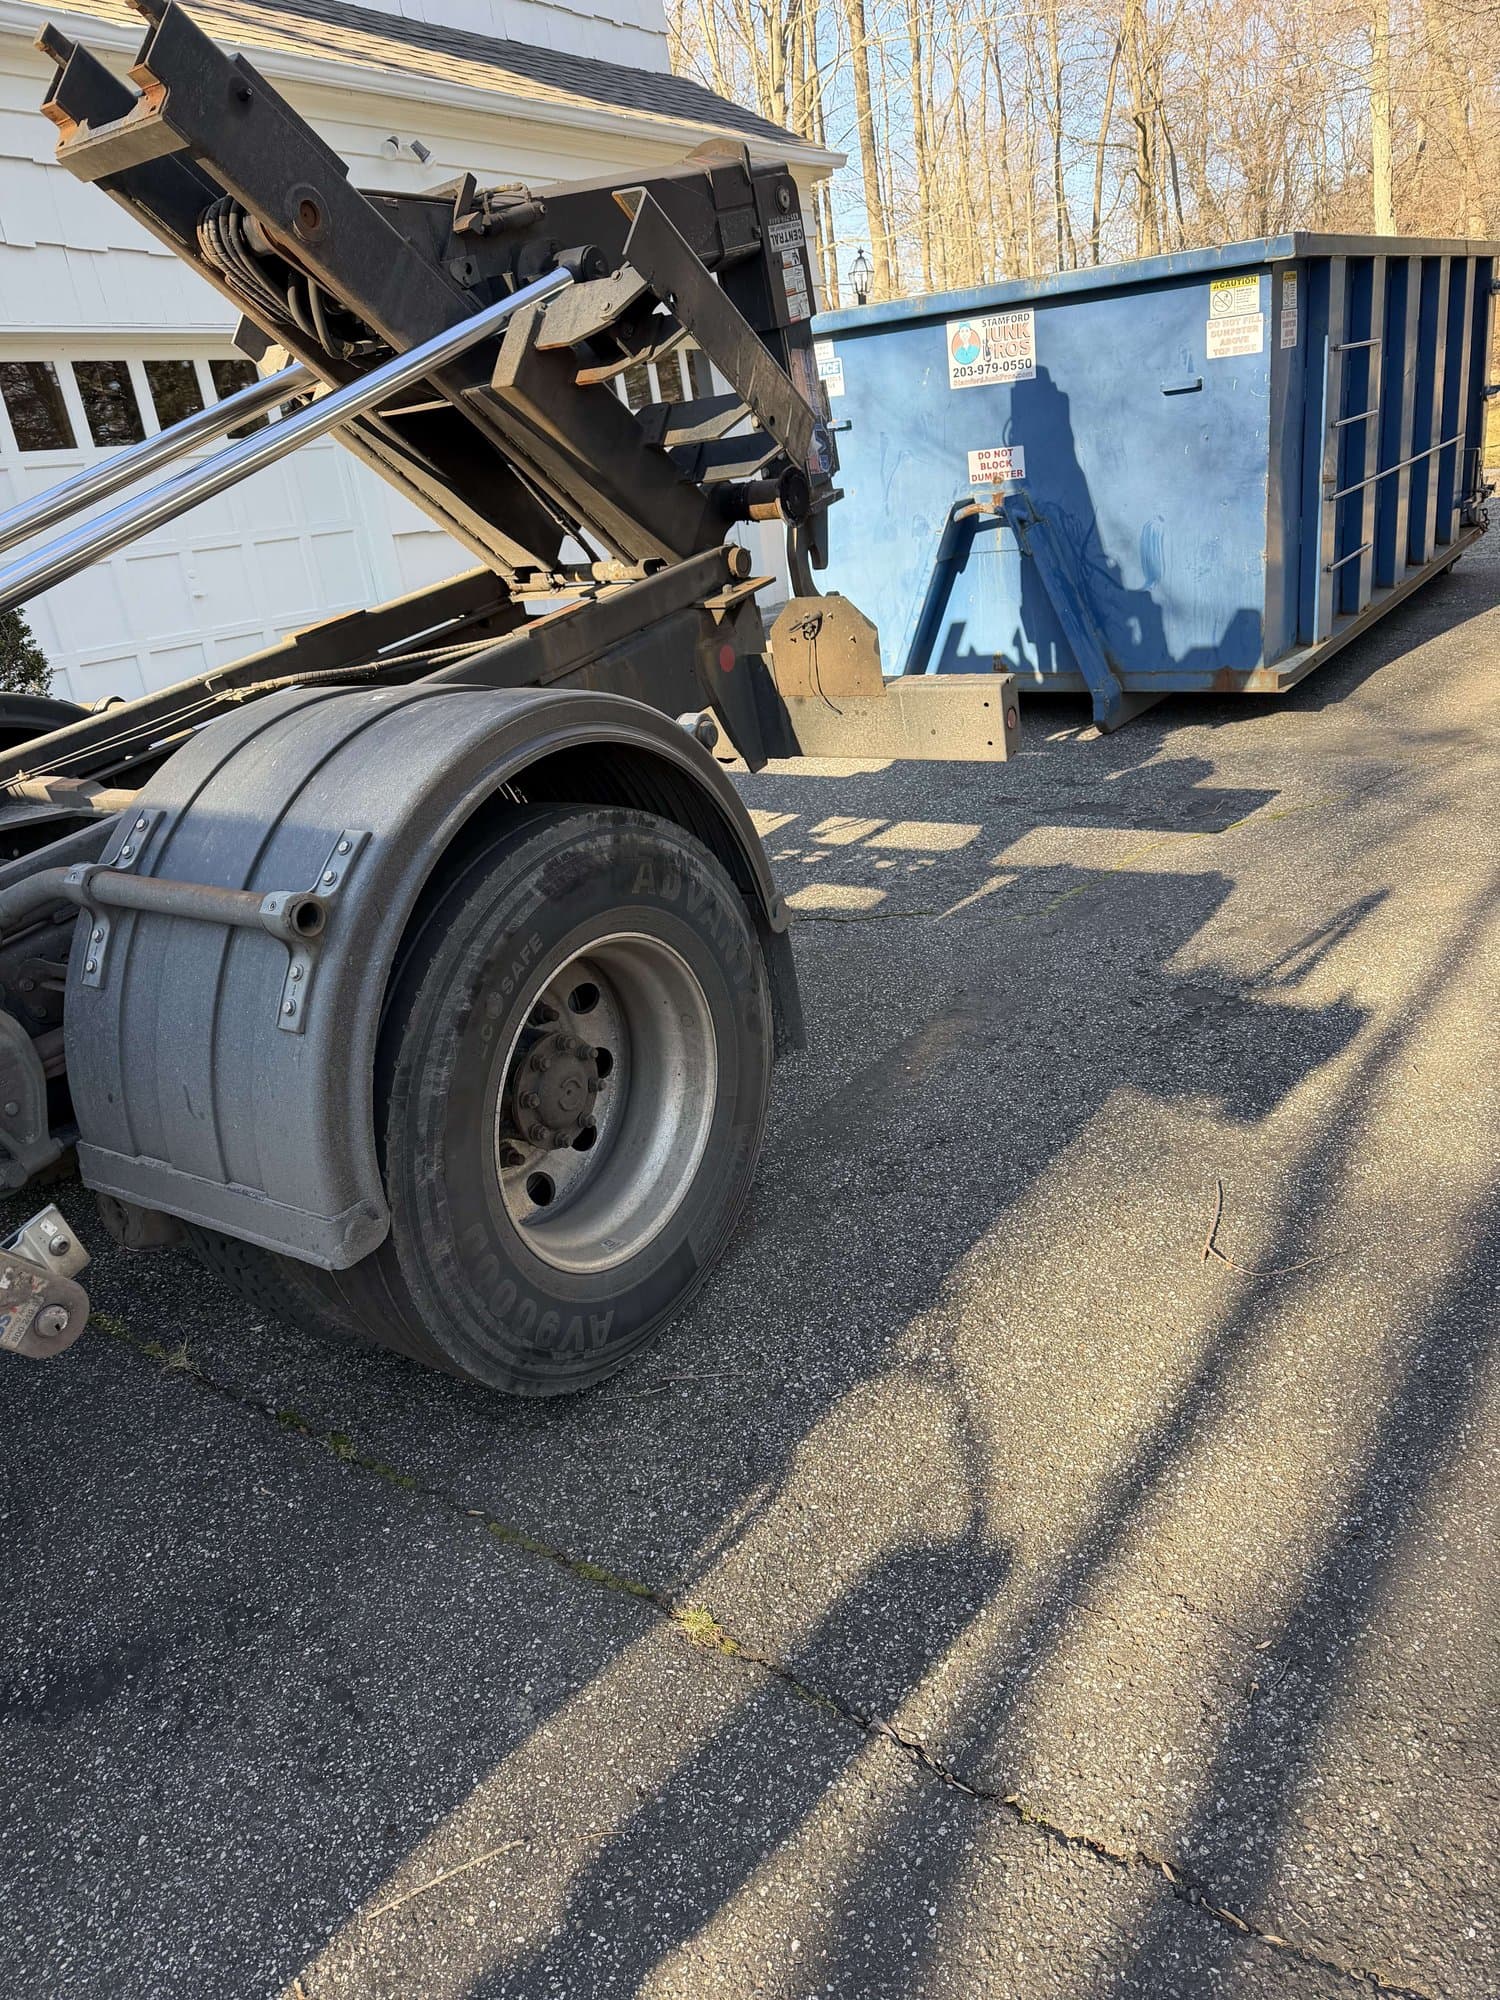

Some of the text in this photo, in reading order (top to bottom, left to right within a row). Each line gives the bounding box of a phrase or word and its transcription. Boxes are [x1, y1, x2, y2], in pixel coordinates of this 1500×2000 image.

[770, 228, 803, 247] CENTRAL
[1219, 275, 1257, 289] CAUTION
[981, 313, 1030, 328] STAMFORD
[984, 322, 1031, 343] JUNK
[1210, 325, 1259, 338] DUMPSTER
[953, 358, 1032, 378] 203-979-0550
[978, 448, 1014, 460] DO NOT
[980, 460, 1013, 471] BLOCK
[971, 469, 1024, 482] DUMPSTER
